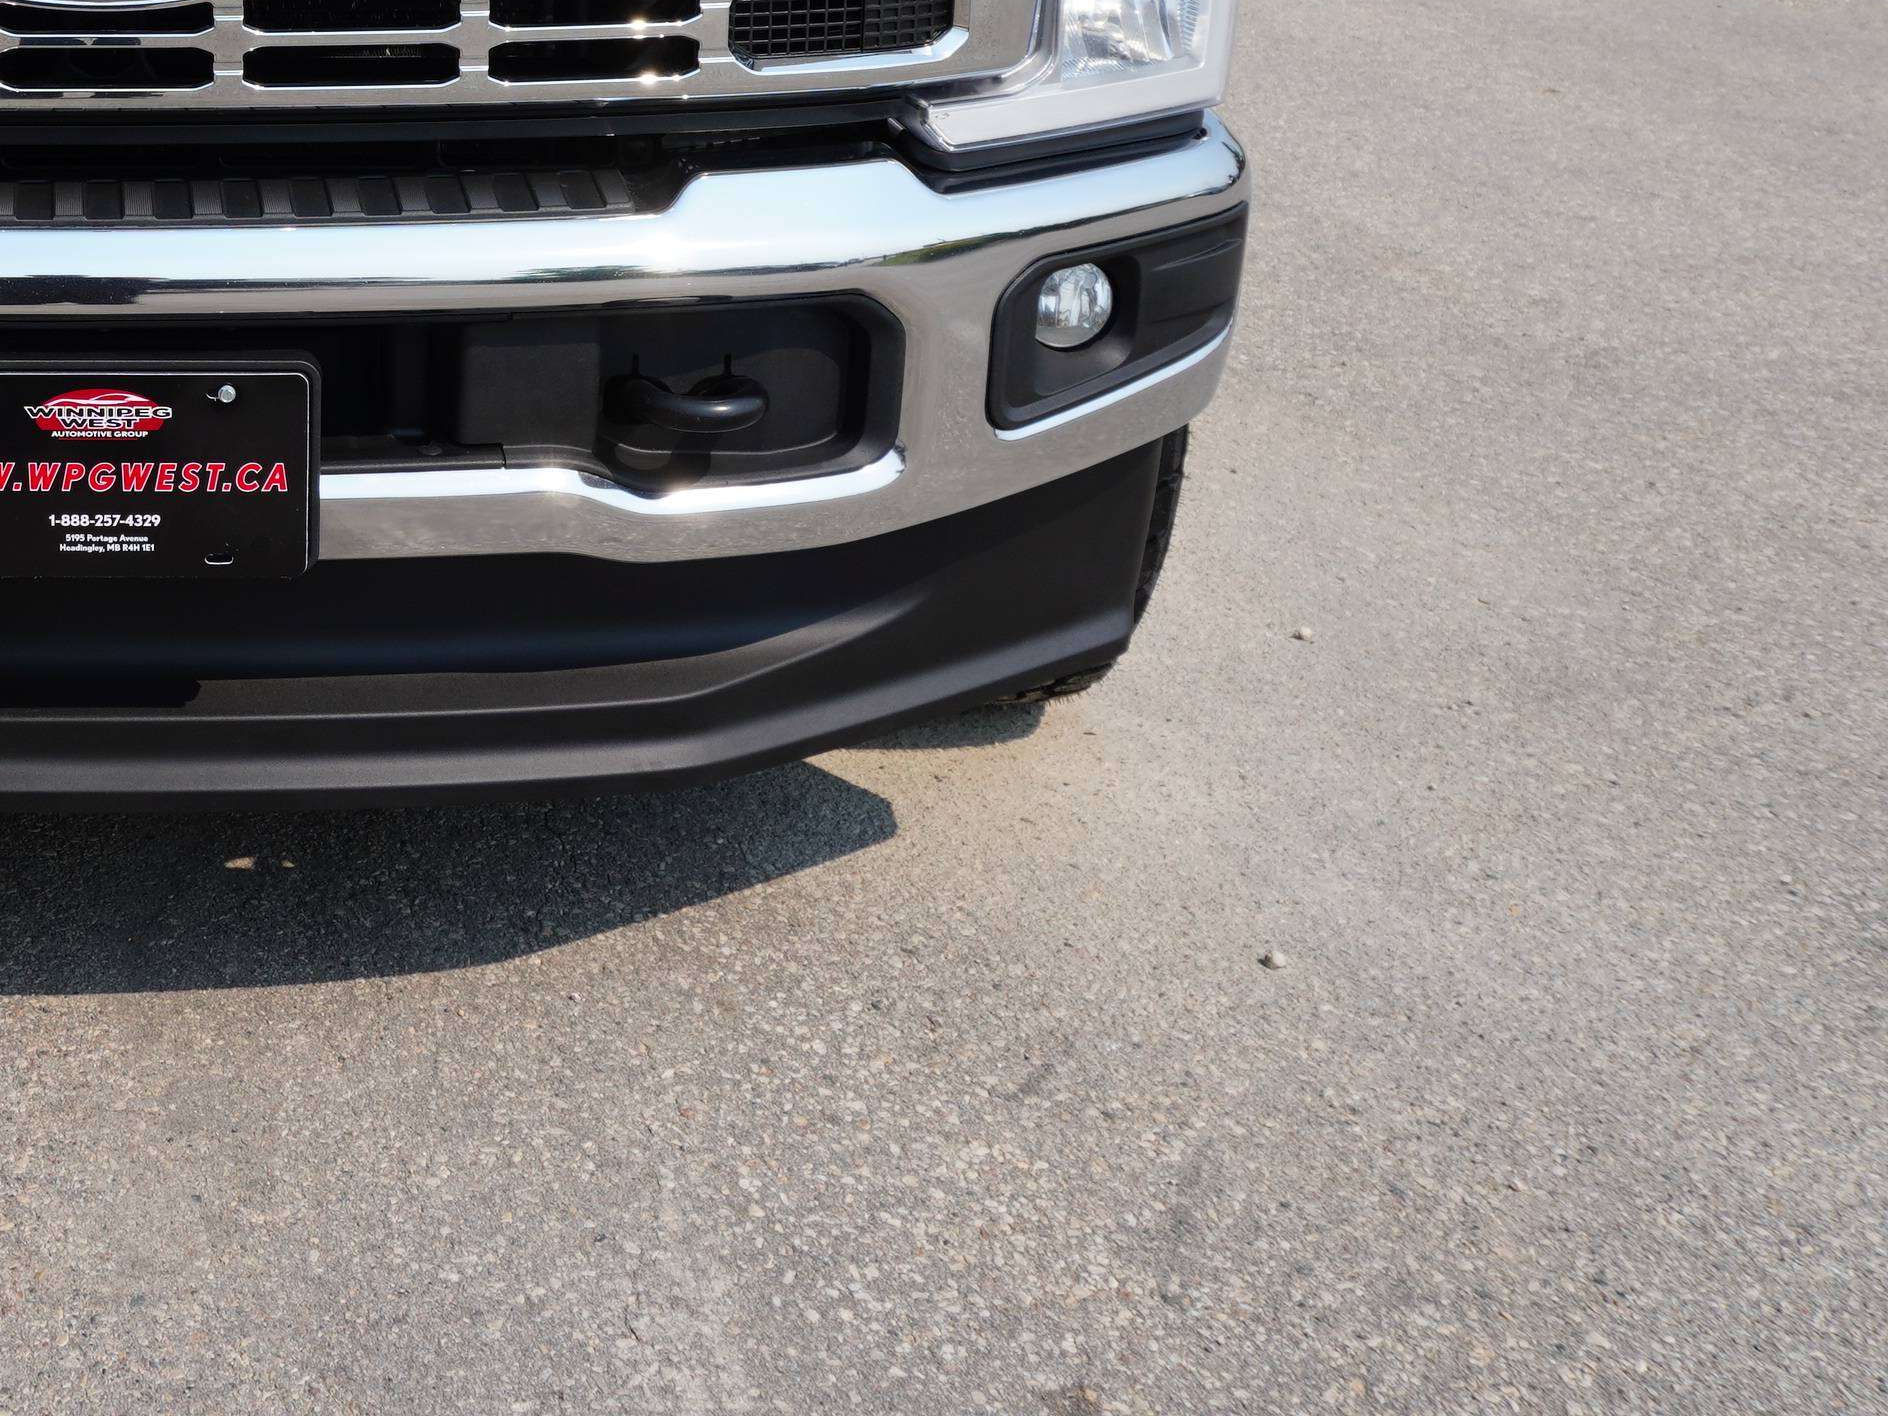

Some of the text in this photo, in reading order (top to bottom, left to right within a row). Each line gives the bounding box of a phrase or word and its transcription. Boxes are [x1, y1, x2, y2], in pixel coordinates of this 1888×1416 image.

[24, 406, 173, 419] WINNIPEG
[58, 418, 140, 430] WEST
[51, 430, 149, 438] AUTOMOTIVE GROUP
[48, 514, 161, 527] 1-888-257-4329
[65, 533, 149, 544] 5195 Portage Avenue
[59, 543, 155, 553] Headingley, MB R4H 1E1
